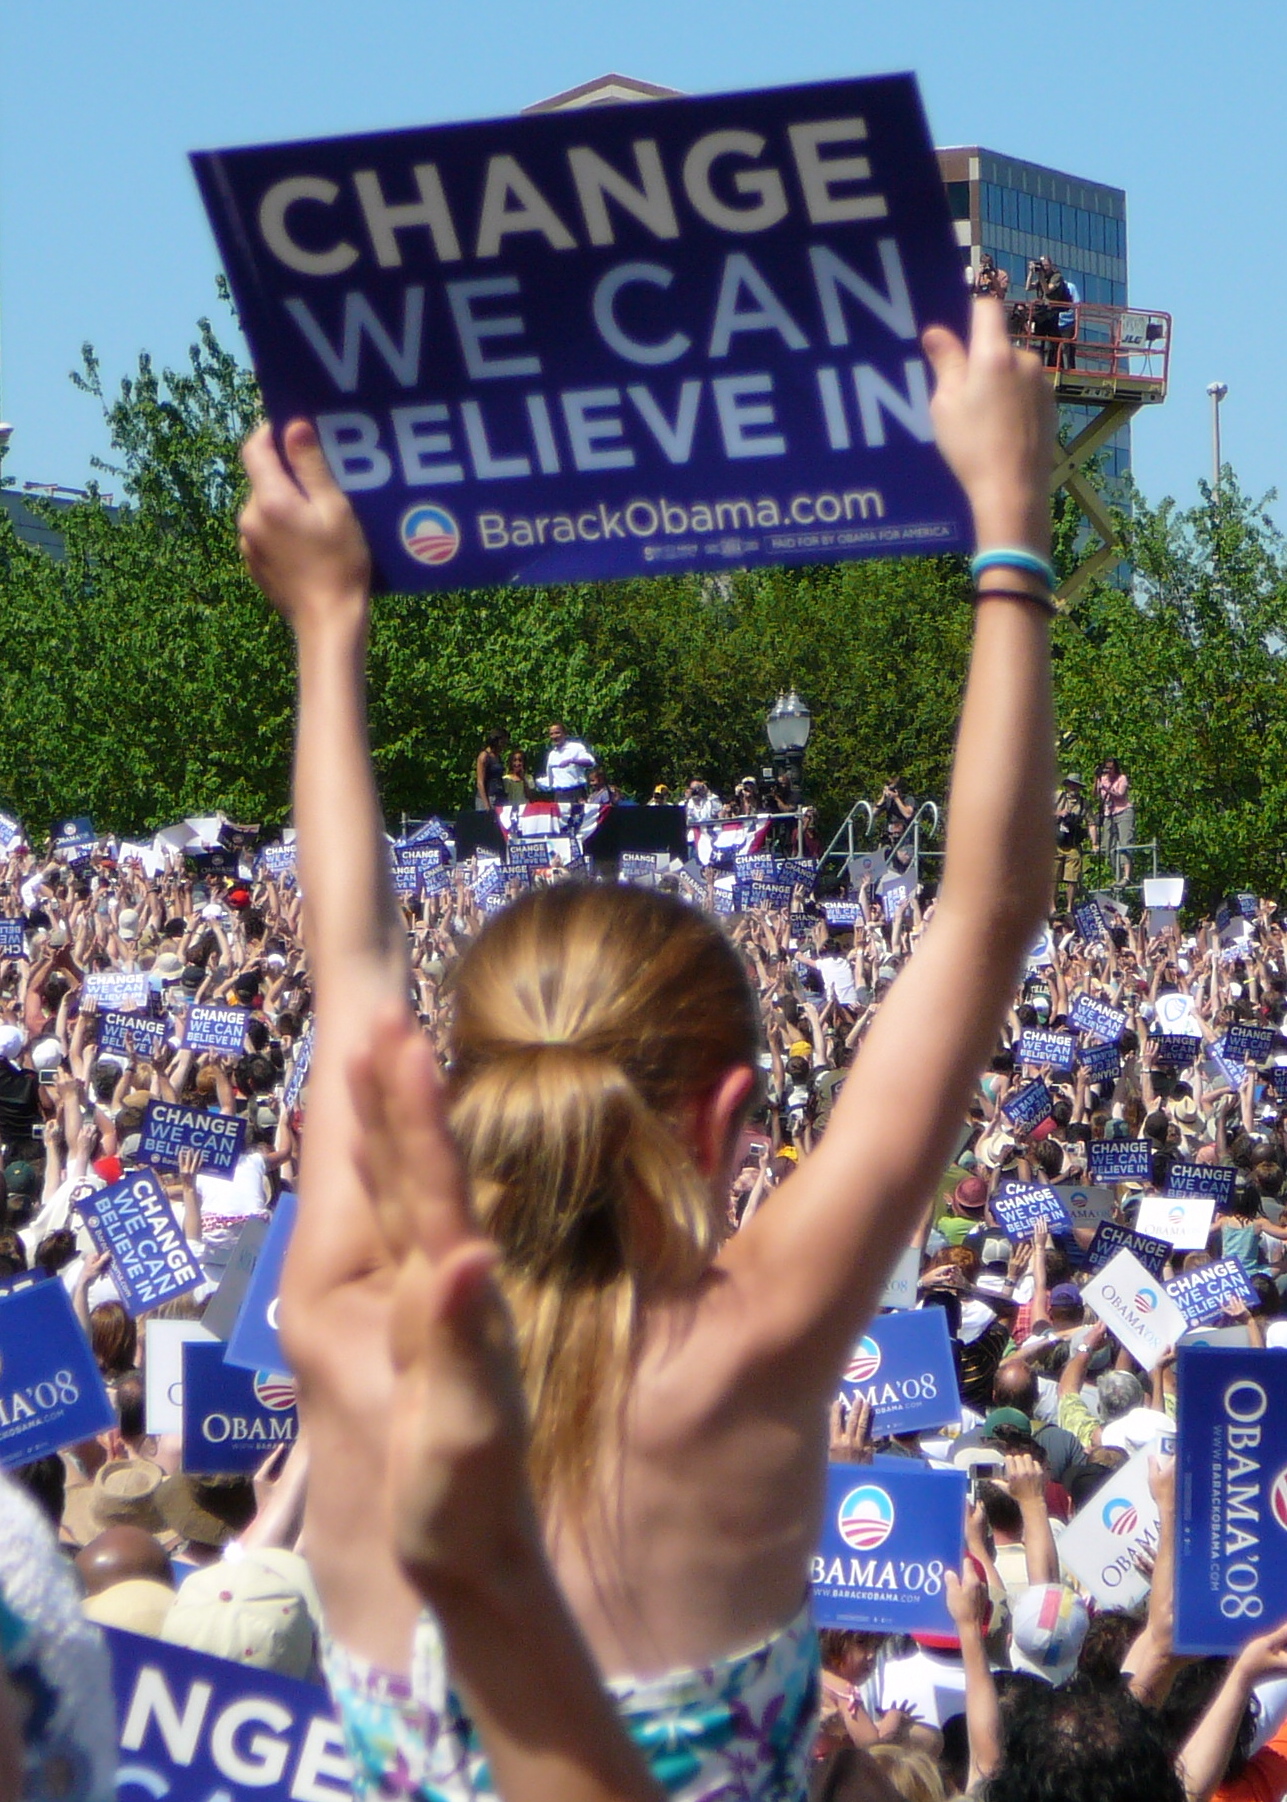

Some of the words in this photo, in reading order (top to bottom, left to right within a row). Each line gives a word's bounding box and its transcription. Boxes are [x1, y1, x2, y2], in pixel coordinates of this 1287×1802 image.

[260, 117, 888, 276] CHANGE
[283, 276, 541, 394] WE
[593, 238, 918, 365] CAN
[316, 372, 786, 492] BELIEVE
[817, 359, 936, 450] IN
[479, 489, 885, 550] BarackObama.com
[772, 537, 796, 549] PAID
[799, 536, 820, 548] FOR
[822, 535, 836, 547] BY
[838, 531, 876, 545] OBAMA
[879, 530, 900, 543] FOR
[901, 526, 949, 542] AMERICA
[402, 850, 439, 859] CHANGE
[510, 843, 545, 853] CHANGE
[623, 853, 656, 863] CHANGE
[736, 854, 772, 864] CHANGE
[752, 883, 791, 893] CHANGE
[87, 974, 144, 985] CHANGE
[87, 985, 108, 993] WE
[114, 984, 143, 993] CAN
[192, 1008, 245, 1025] CHANGE
[1078, 1005, 1094, 1019] WE
[1097, 1014, 1121, 1031] CAN
[1081, 996, 1125, 1024] CHANGE
[106, 1013, 165, 1036] CHANGE
[190, 1020, 210, 1032] WE
[214, 1022, 244, 1037] CAN
[1072, 1013, 1106, 1034] BELIEVE
[1108, 1028, 1118, 1039] IN
[104, 1024, 127, 1037] WE
[132, 1030, 163, 1046] CAN
[187, 1032, 228, 1045] BELIEVE
[230, 1037, 241, 1047] IN
[1023, 1030, 1072, 1046] CHANGE
[1231, 1026, 1272, 1042] CHANGE
[1023, 1040, 1041, 1051] WE
[1045, 1043, 1071, 1056] CAN
[1170, 1045, 1196, 1054] CAN
[1230, 1036, 1247, 1047] WE
[1250, 1038, 1270, 1050] CAN
[1020, 1049, 1057, 1061] BELIEVE
[1059, 1055, 1069, 1063] IN
[152, 1105, 240, 1137] CHANGE
[149, 1122, 184, 1143] WE
[190, 1131, 235, 1153] CAN
[1092, 1142, 1148, 1155] CHANGE
[214, 1153, 231, 1167] IN
[1092, 1154, 1114, 1165] WE
[1118, 1153, 1148, 1164] CAN
[1091, 1164, 1135, 1175] BELIEVE
[1137, 1164, 1148, 1173] IN
[1171, 1164, 1232, 1181] CHANGE
[1170, 1177, 1194, 1190] WE
[1199, 1180, 1230, 1194] CAN
[995, 1188, 1054, 1212] CHANGE
[1216, 1194, 1228, 1204] IN
[1000, 1208, 1026, 1223] WE
[1028, 1199, 1060, 1216] CAN
[1052, 1210, 1065, 1220] IN
[113, 1188, 146, 1235] WE
[138, 1240, 177, 1295] CAN
[133, 1180, 196, 1287] CHANGE
[1101, 1226, 1168, 1258] CHANGE
[95, 1197, 145, 1280] BELIEVE
[135, 1282, 158, 1303] IN
[1166, 1260, 1239, 1298] CHANGE
[1175, 1288, 1204, 1310] WE
[1206, 1274, 1245, 1296] CAN
[1236, 1286, 1250, 1299] IN
[203, 1413, 298, 1443] OBAM
[1220, 1380, 1267, 1619] OBAMA'08
[1210, 1425, 1222, 1592] WWW.BARACKOBAMA.COM
